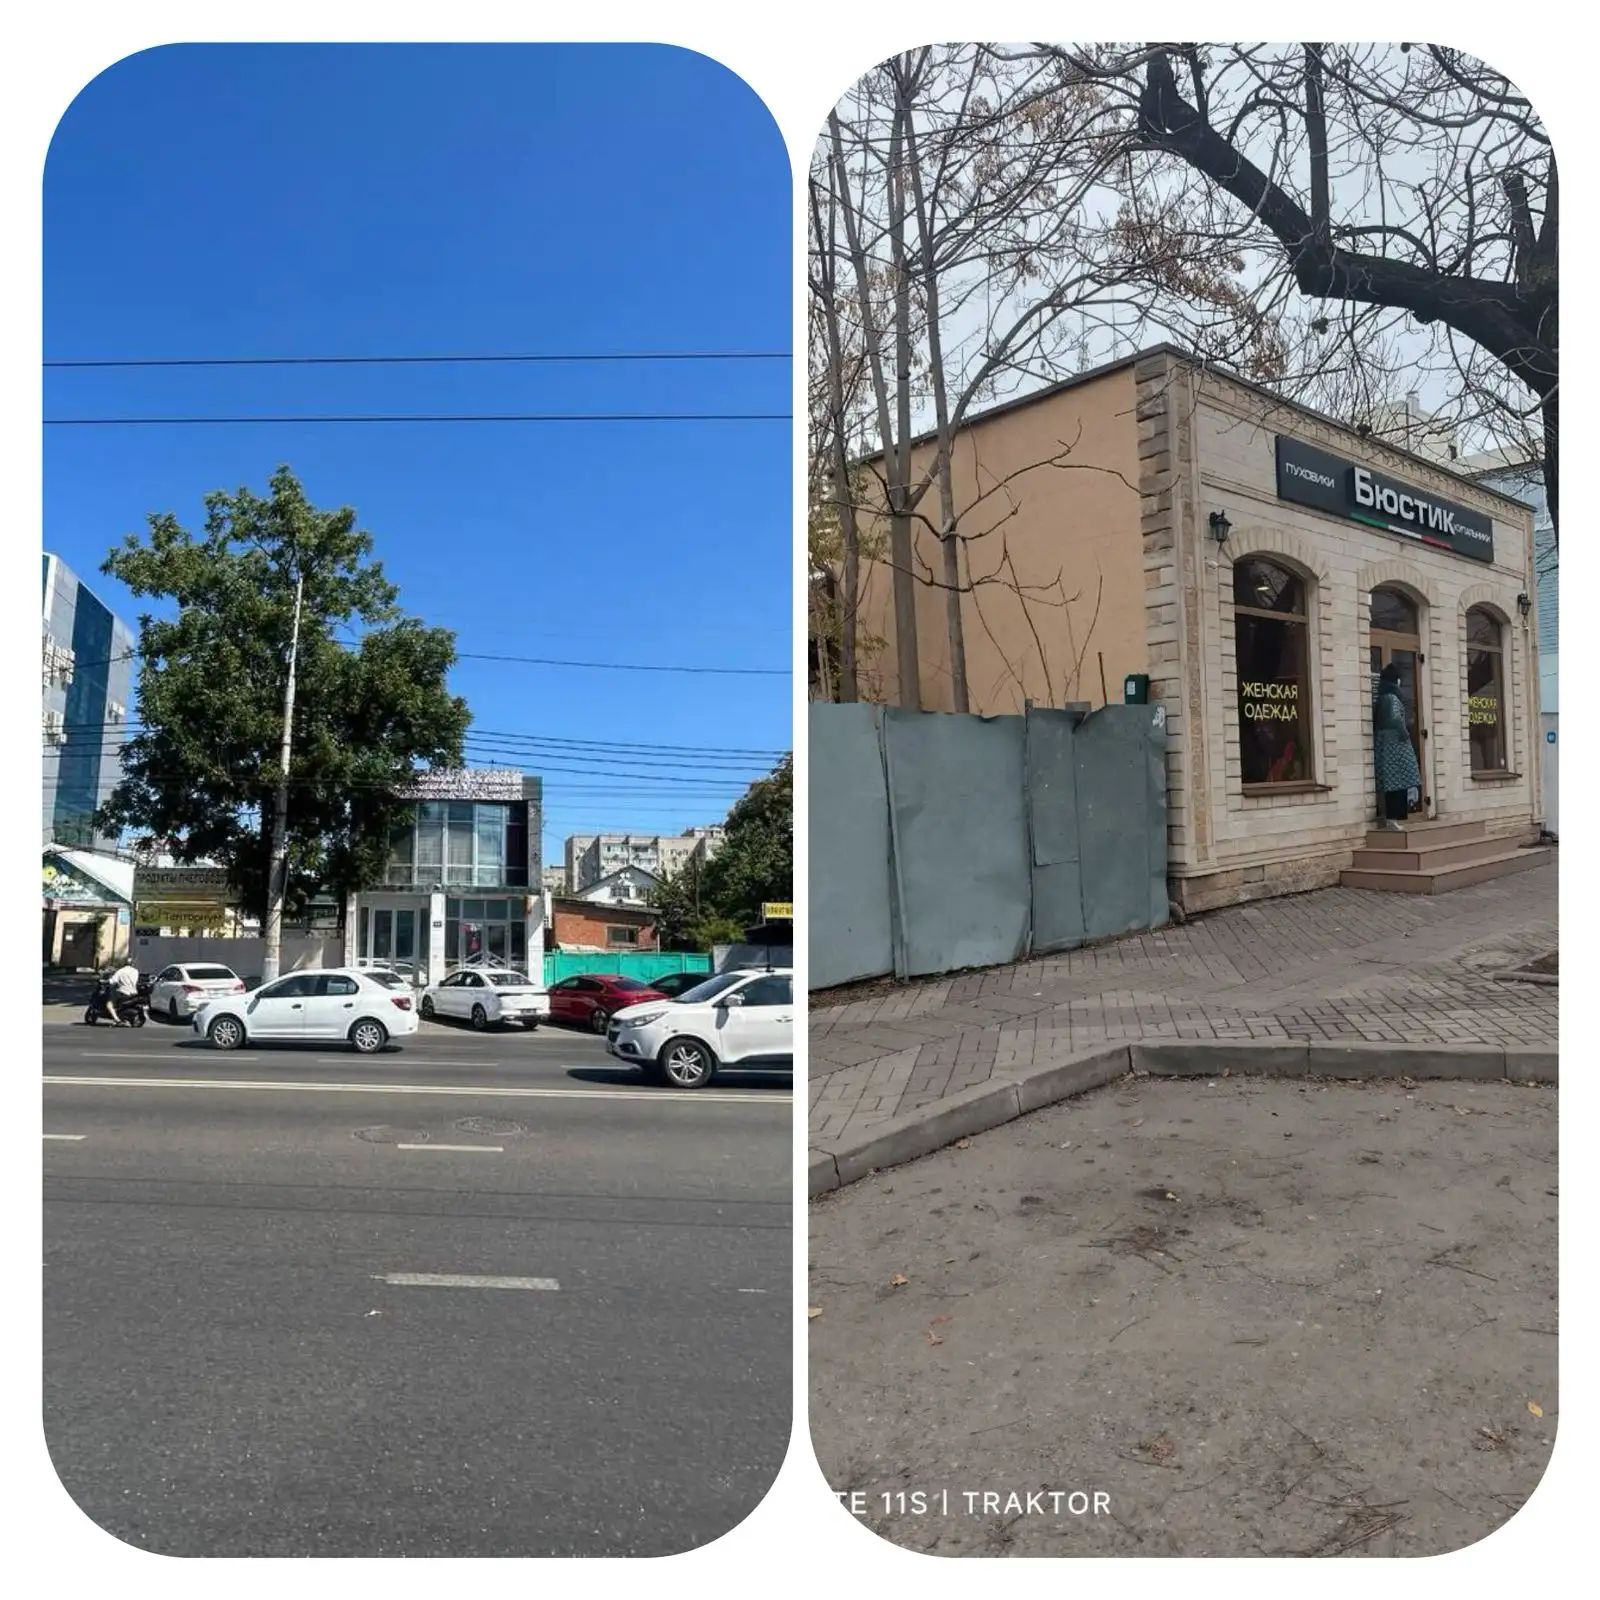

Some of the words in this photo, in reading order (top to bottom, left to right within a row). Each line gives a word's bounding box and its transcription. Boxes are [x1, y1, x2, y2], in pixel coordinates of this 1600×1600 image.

[1285, 462, 1335, 489] ПУХОВИКИ
[1242, 681, 1298, 699] ЖЕНСКАЯ
[1244, 703, 1298, 722] ОДЕЖДА
